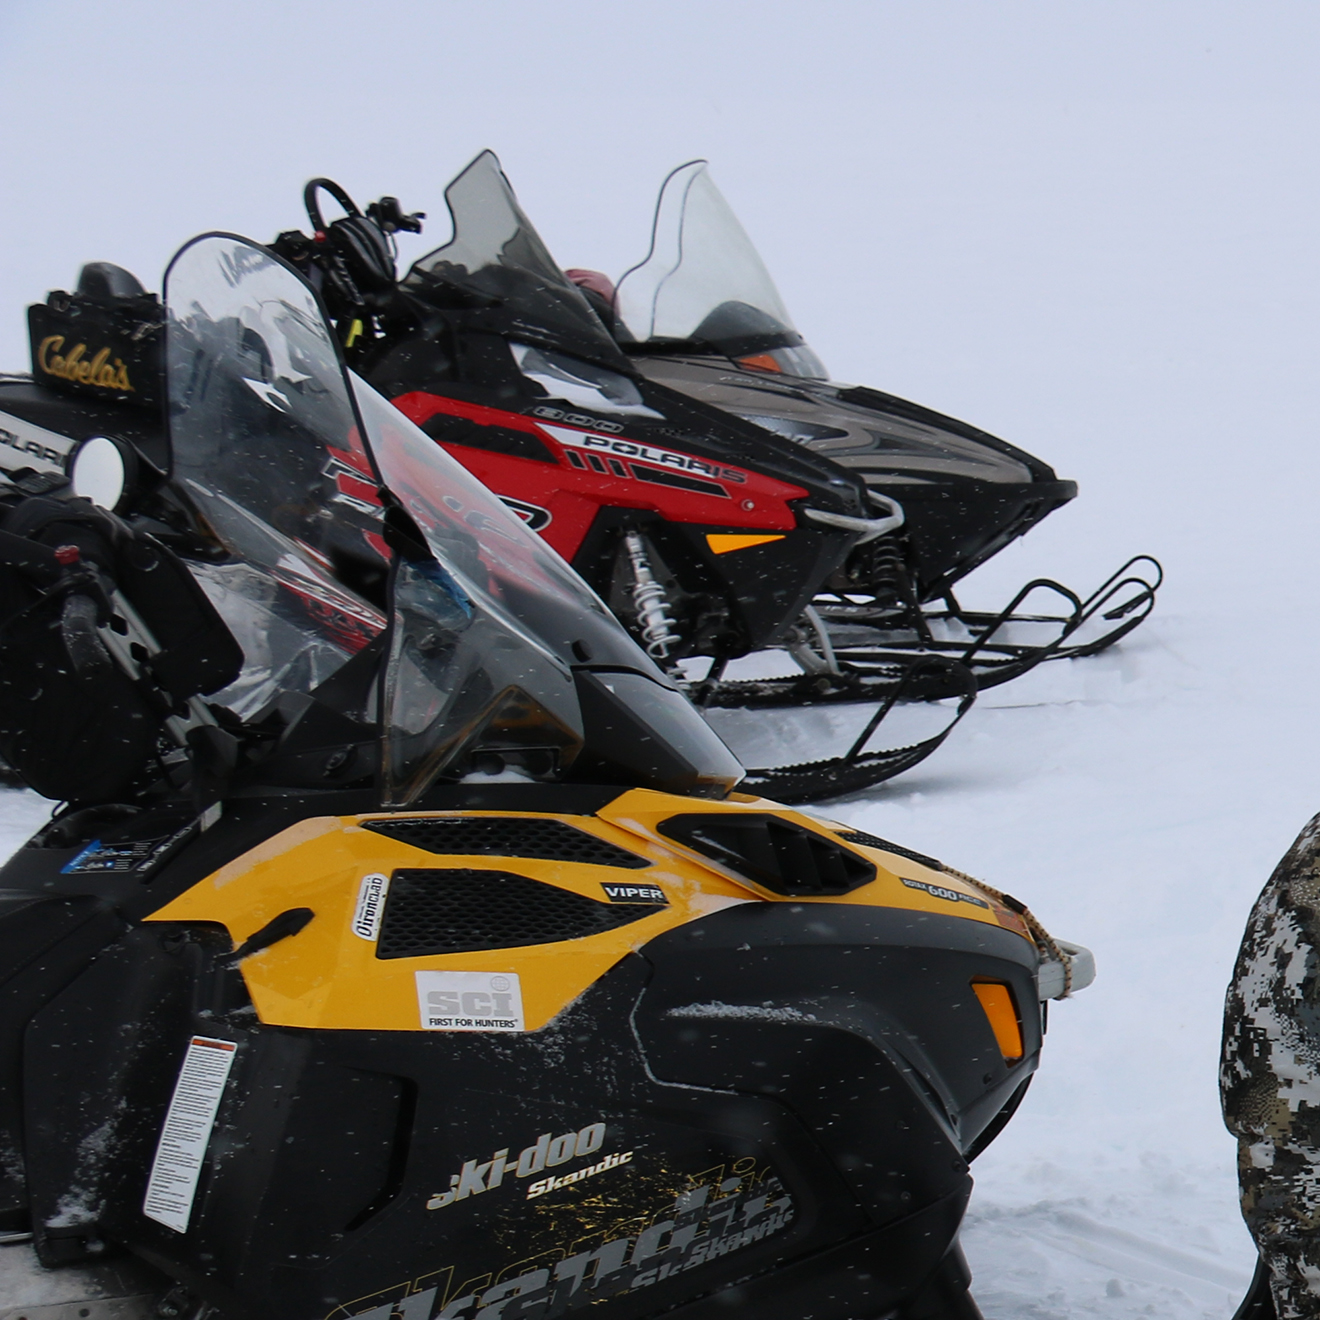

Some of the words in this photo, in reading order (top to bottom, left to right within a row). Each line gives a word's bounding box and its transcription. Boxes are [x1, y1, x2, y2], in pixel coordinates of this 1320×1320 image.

[582, 435, 748, 484] POLARIS
[605, 886, 664, 899] VIPER
[927, 885, 958, 900] 600
[427, 991, 514, 1017] SCI
[429, 1018, 453, 1026] FIRST
[455, 1018, 473, 1027] FOR
[526, 1150, 634, 1200] Skandic
